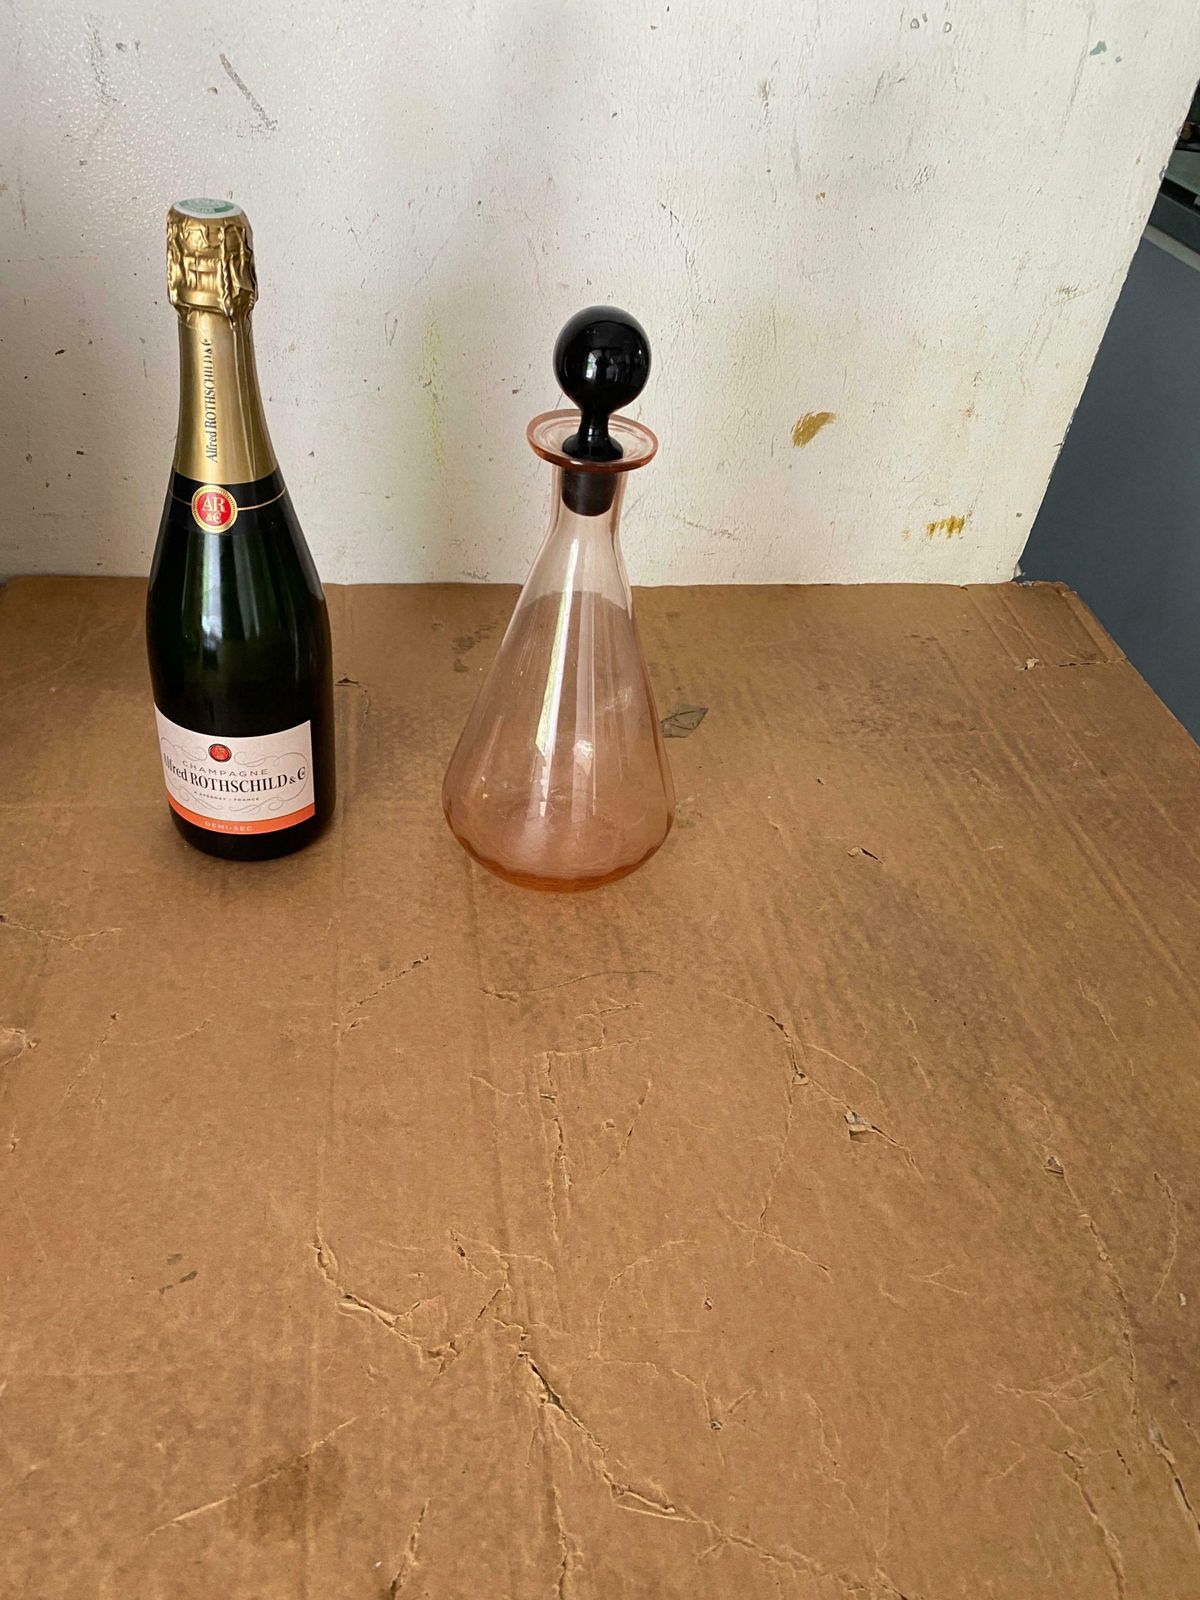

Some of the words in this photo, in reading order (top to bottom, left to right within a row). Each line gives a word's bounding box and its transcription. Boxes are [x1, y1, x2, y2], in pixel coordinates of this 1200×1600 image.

[204, 431, 218, 463] Alfred
[201, 495, 226, 513] AR
[182, 760, 270, 777] CHAMPAGNE
[190, 771, 288, 793] ROTHSCHILD
[204, 820, 254, 832] DEMI-SEC
